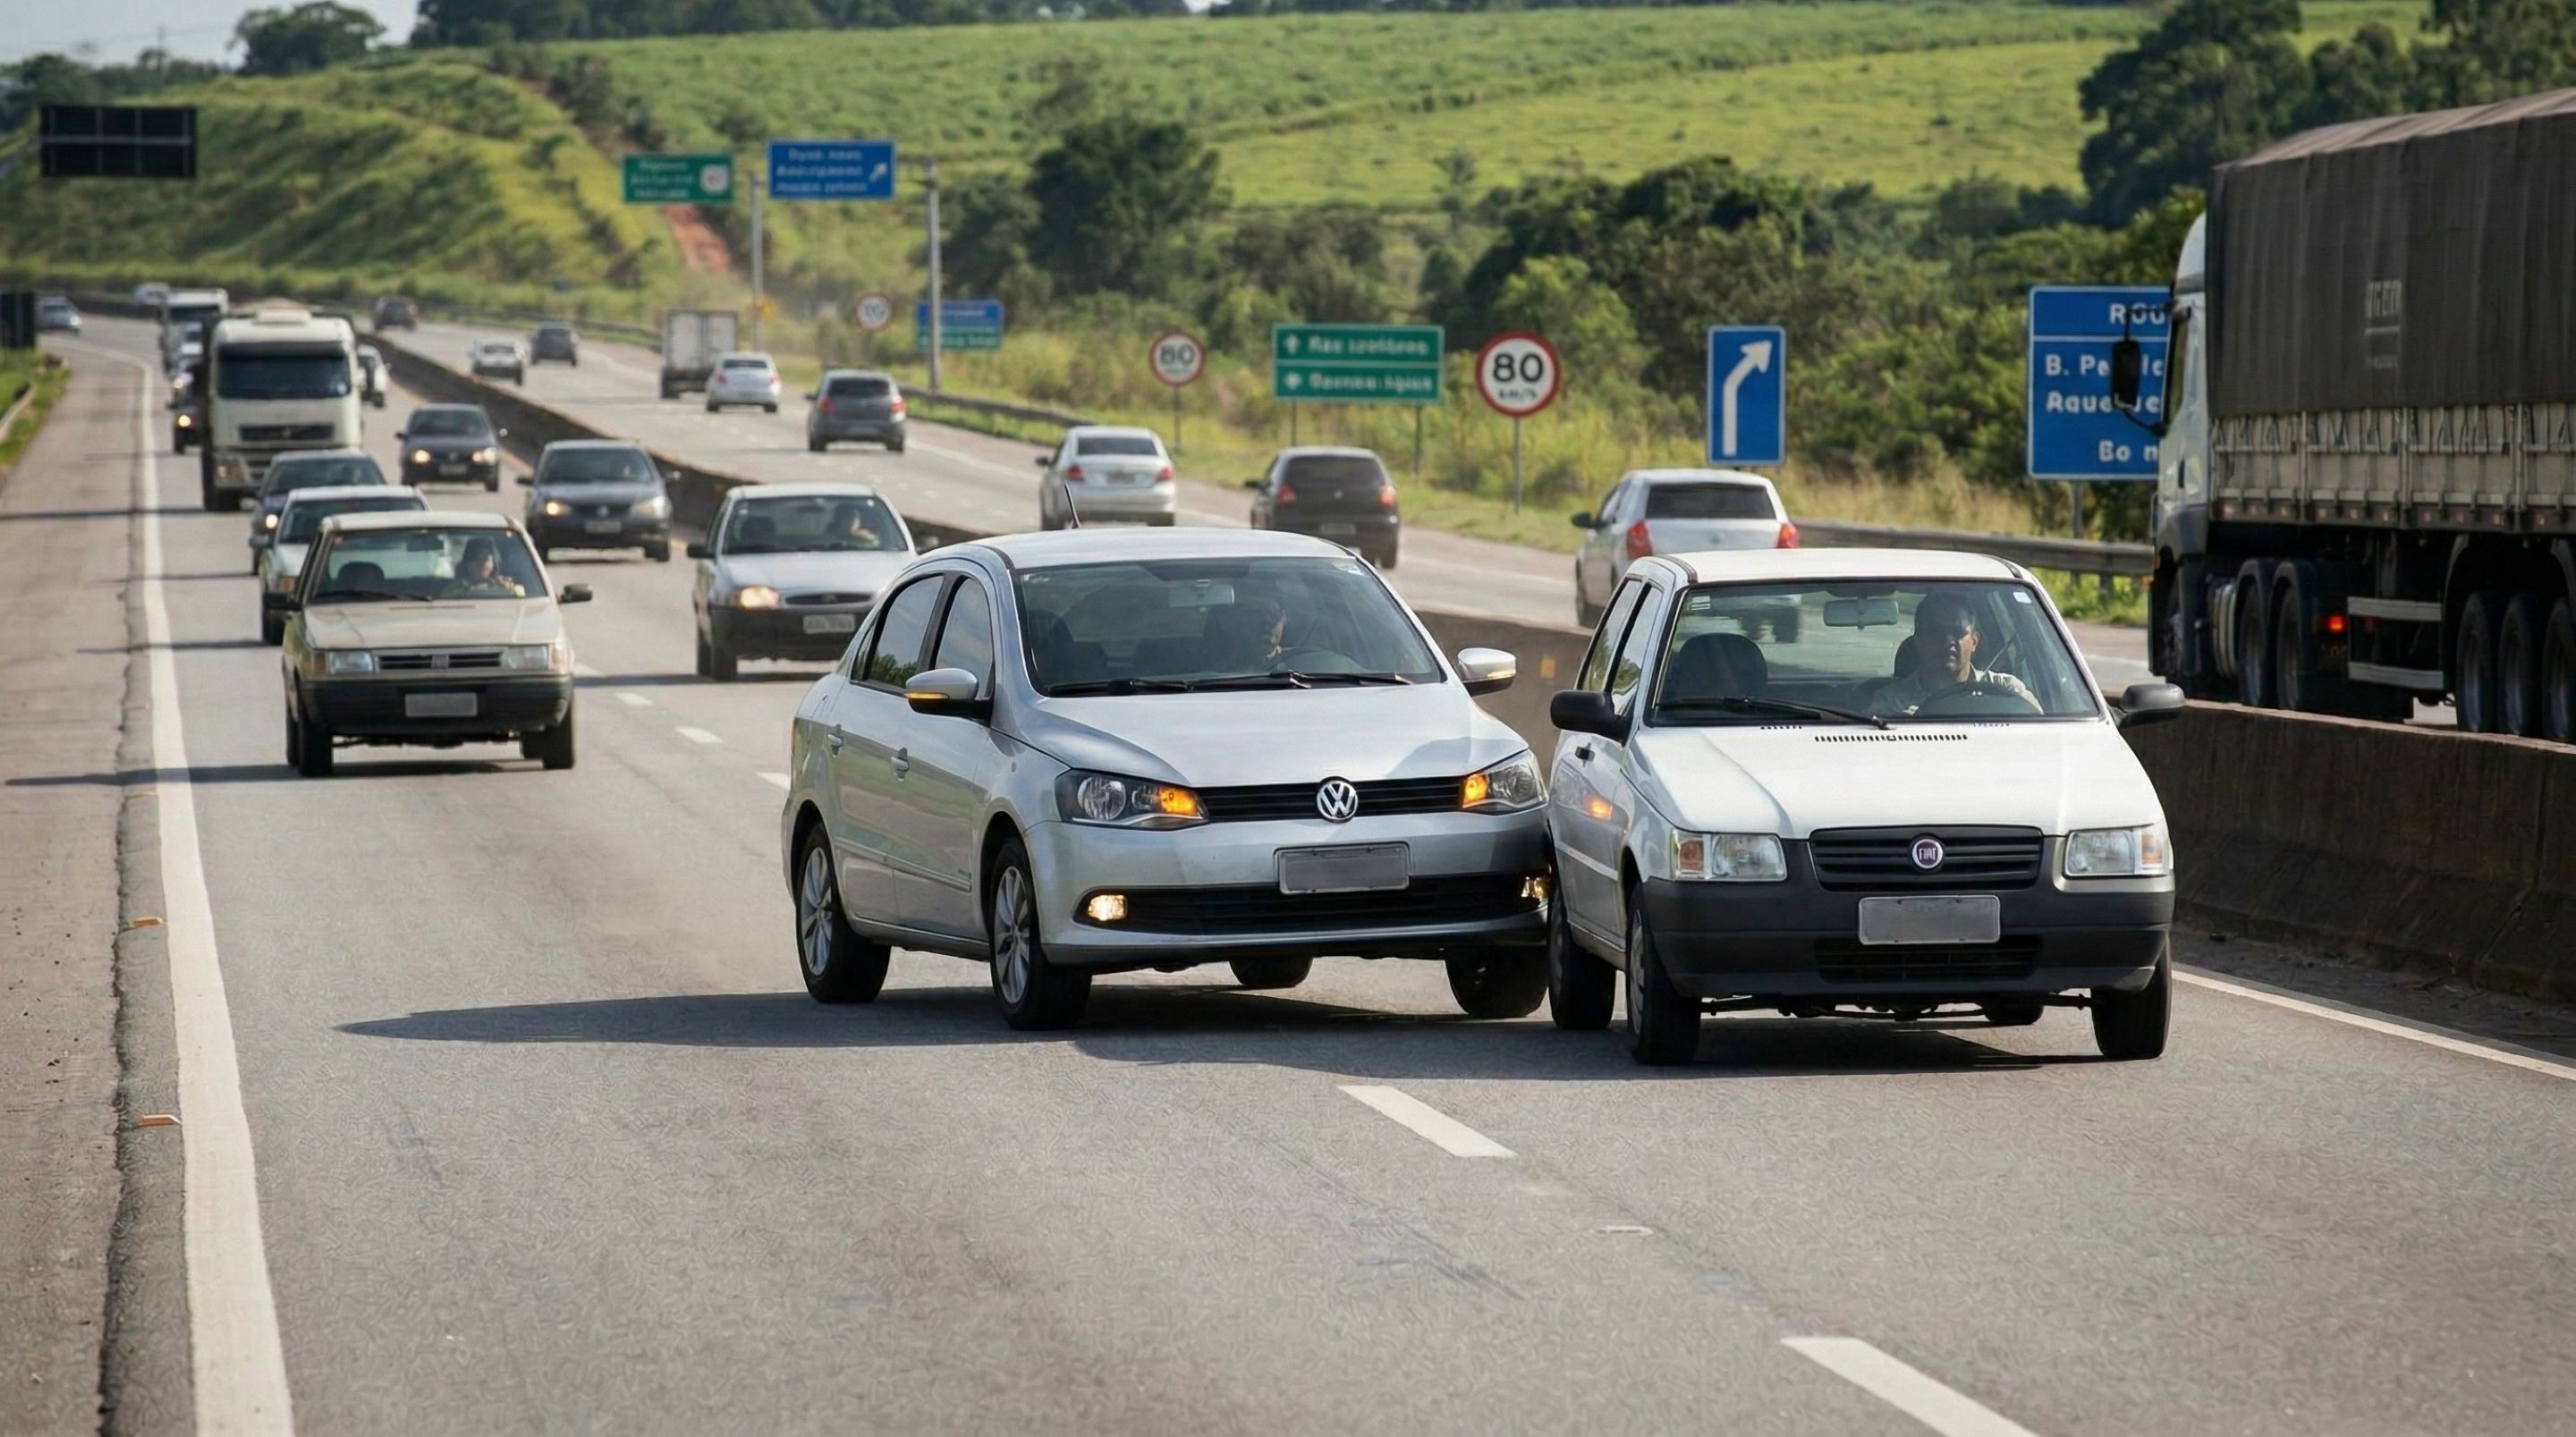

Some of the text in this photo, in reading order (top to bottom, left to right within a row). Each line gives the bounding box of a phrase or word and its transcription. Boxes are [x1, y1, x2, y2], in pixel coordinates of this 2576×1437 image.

[1160, 344, 1195, 366] 80
[2045, 354, 2070, 376] B.
[1494, 352, 1543, 383] 80
[2098, 439, 2131, 462] Bo
[1318, 781, 1359, 820] VW
[1919, 847, 1937, 861] FIAT
